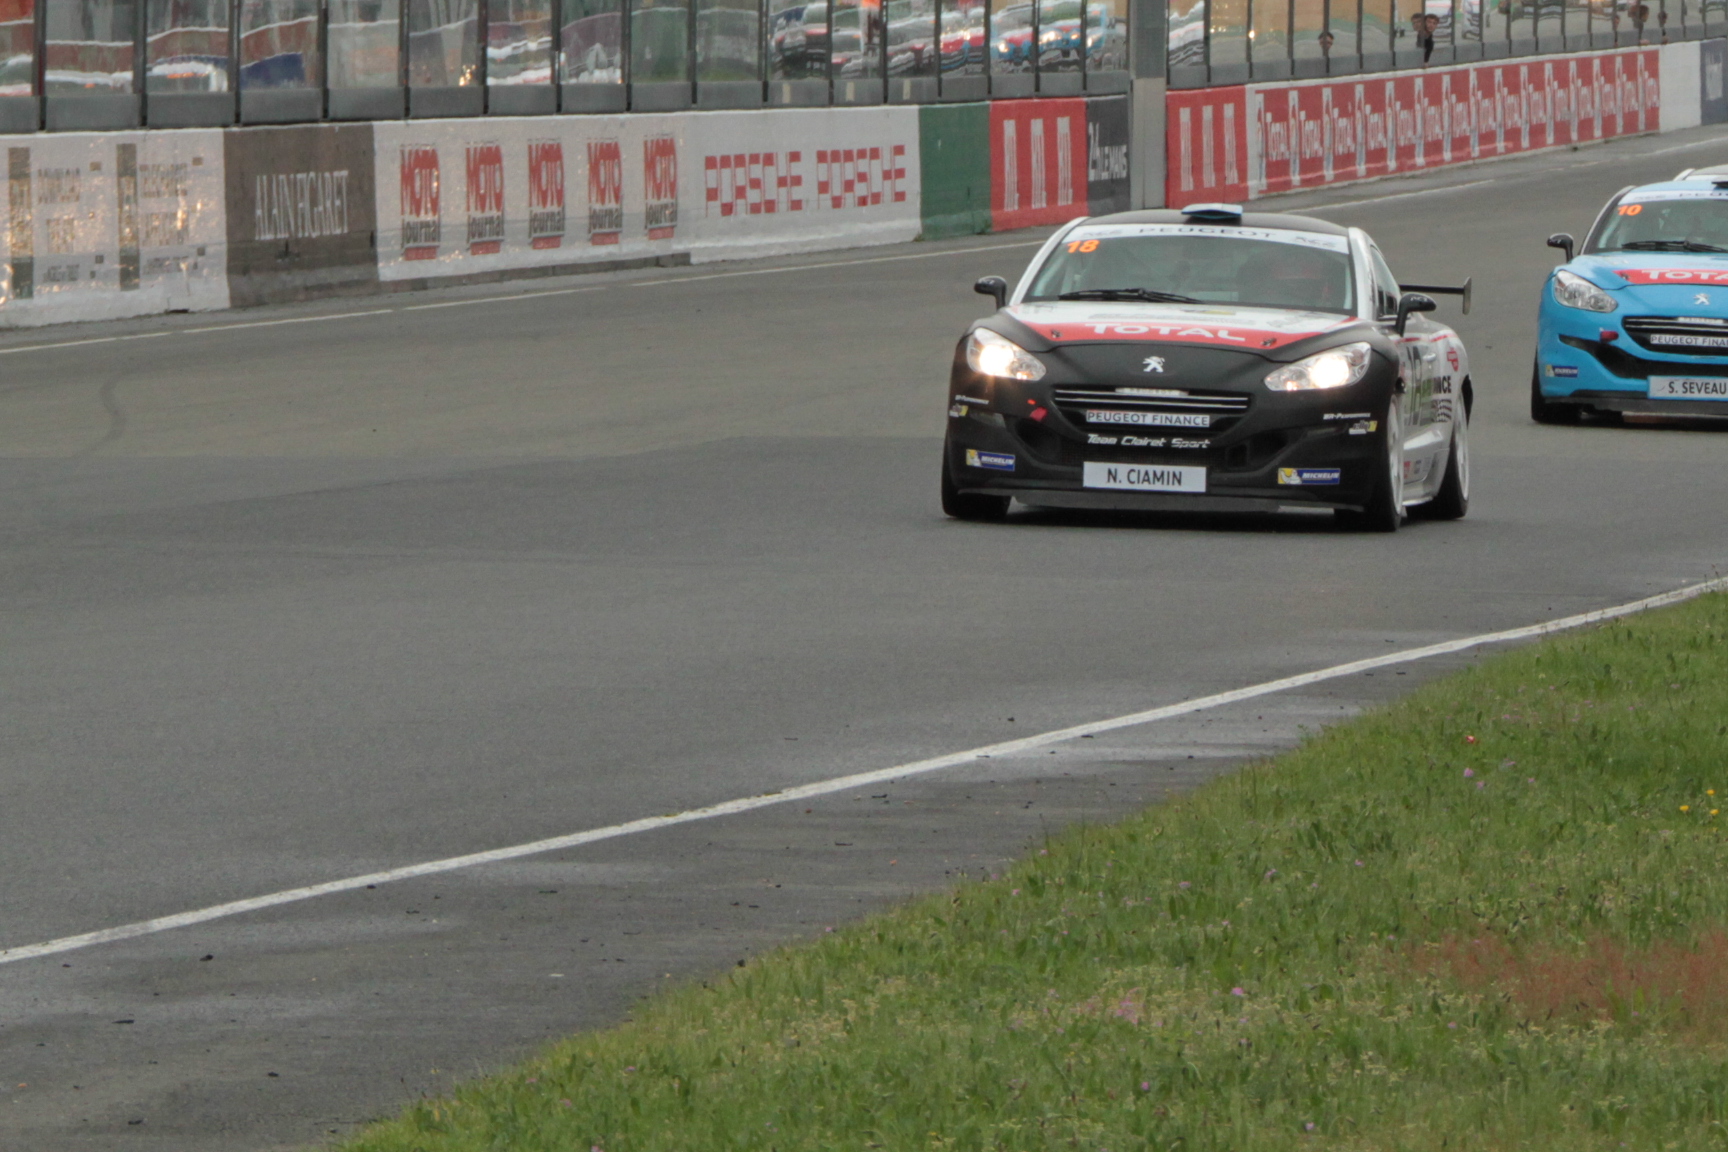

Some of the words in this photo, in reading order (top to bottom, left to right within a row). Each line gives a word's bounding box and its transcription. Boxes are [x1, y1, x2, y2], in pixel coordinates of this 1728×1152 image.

[1266, 112, 1291, 161] TOTAL
[1300, 110, 1323, 159] TOTAL
[1333, 107, 1356, 156] TOTAL
[465, 143, 504, 213] MOTO
[528, 141, 564, 208] MOTO
[587, 140, 622, 206] MOTO
[644, 136, 678, 204] MOTO
[400, 148, 440, 218] MOTO
[589, 204, 623, 237] journal
[645, 201, 678, 232] journal
[1617, 204, 1642, 216] 10
[402, 217, 440, 248] journal
[467, 210, 504, 244] journal
[529, 207, 565, 239] journal
[1139, 227, 1277, 238] PEUGEOT
[1066, 239, 1099, 253] 18
[1085, 323, 1246, 342] TOTAL
[1651, 335, 1698, 345] PEUGEOT
[1668, 381, 1679, 394] S.
[1682, 381, 1728, 395] SEVEAU
[1087, 411, 1148, 423] PEUGEOT
[1152, 415, 1209, 426] FINANCE
[1087, 433, 1117, 445] Team
[1121, 436, 1167, 447] Clairet
[1171, 438, 1211, 449] Sport
[980, 455, 1015, 466] MICHELIN
[1106, 468, 1122, 483] N.
[1127, 469, 1182, 486] CIAMIN
[1302, 471, 1341, 481] MICHELIN
